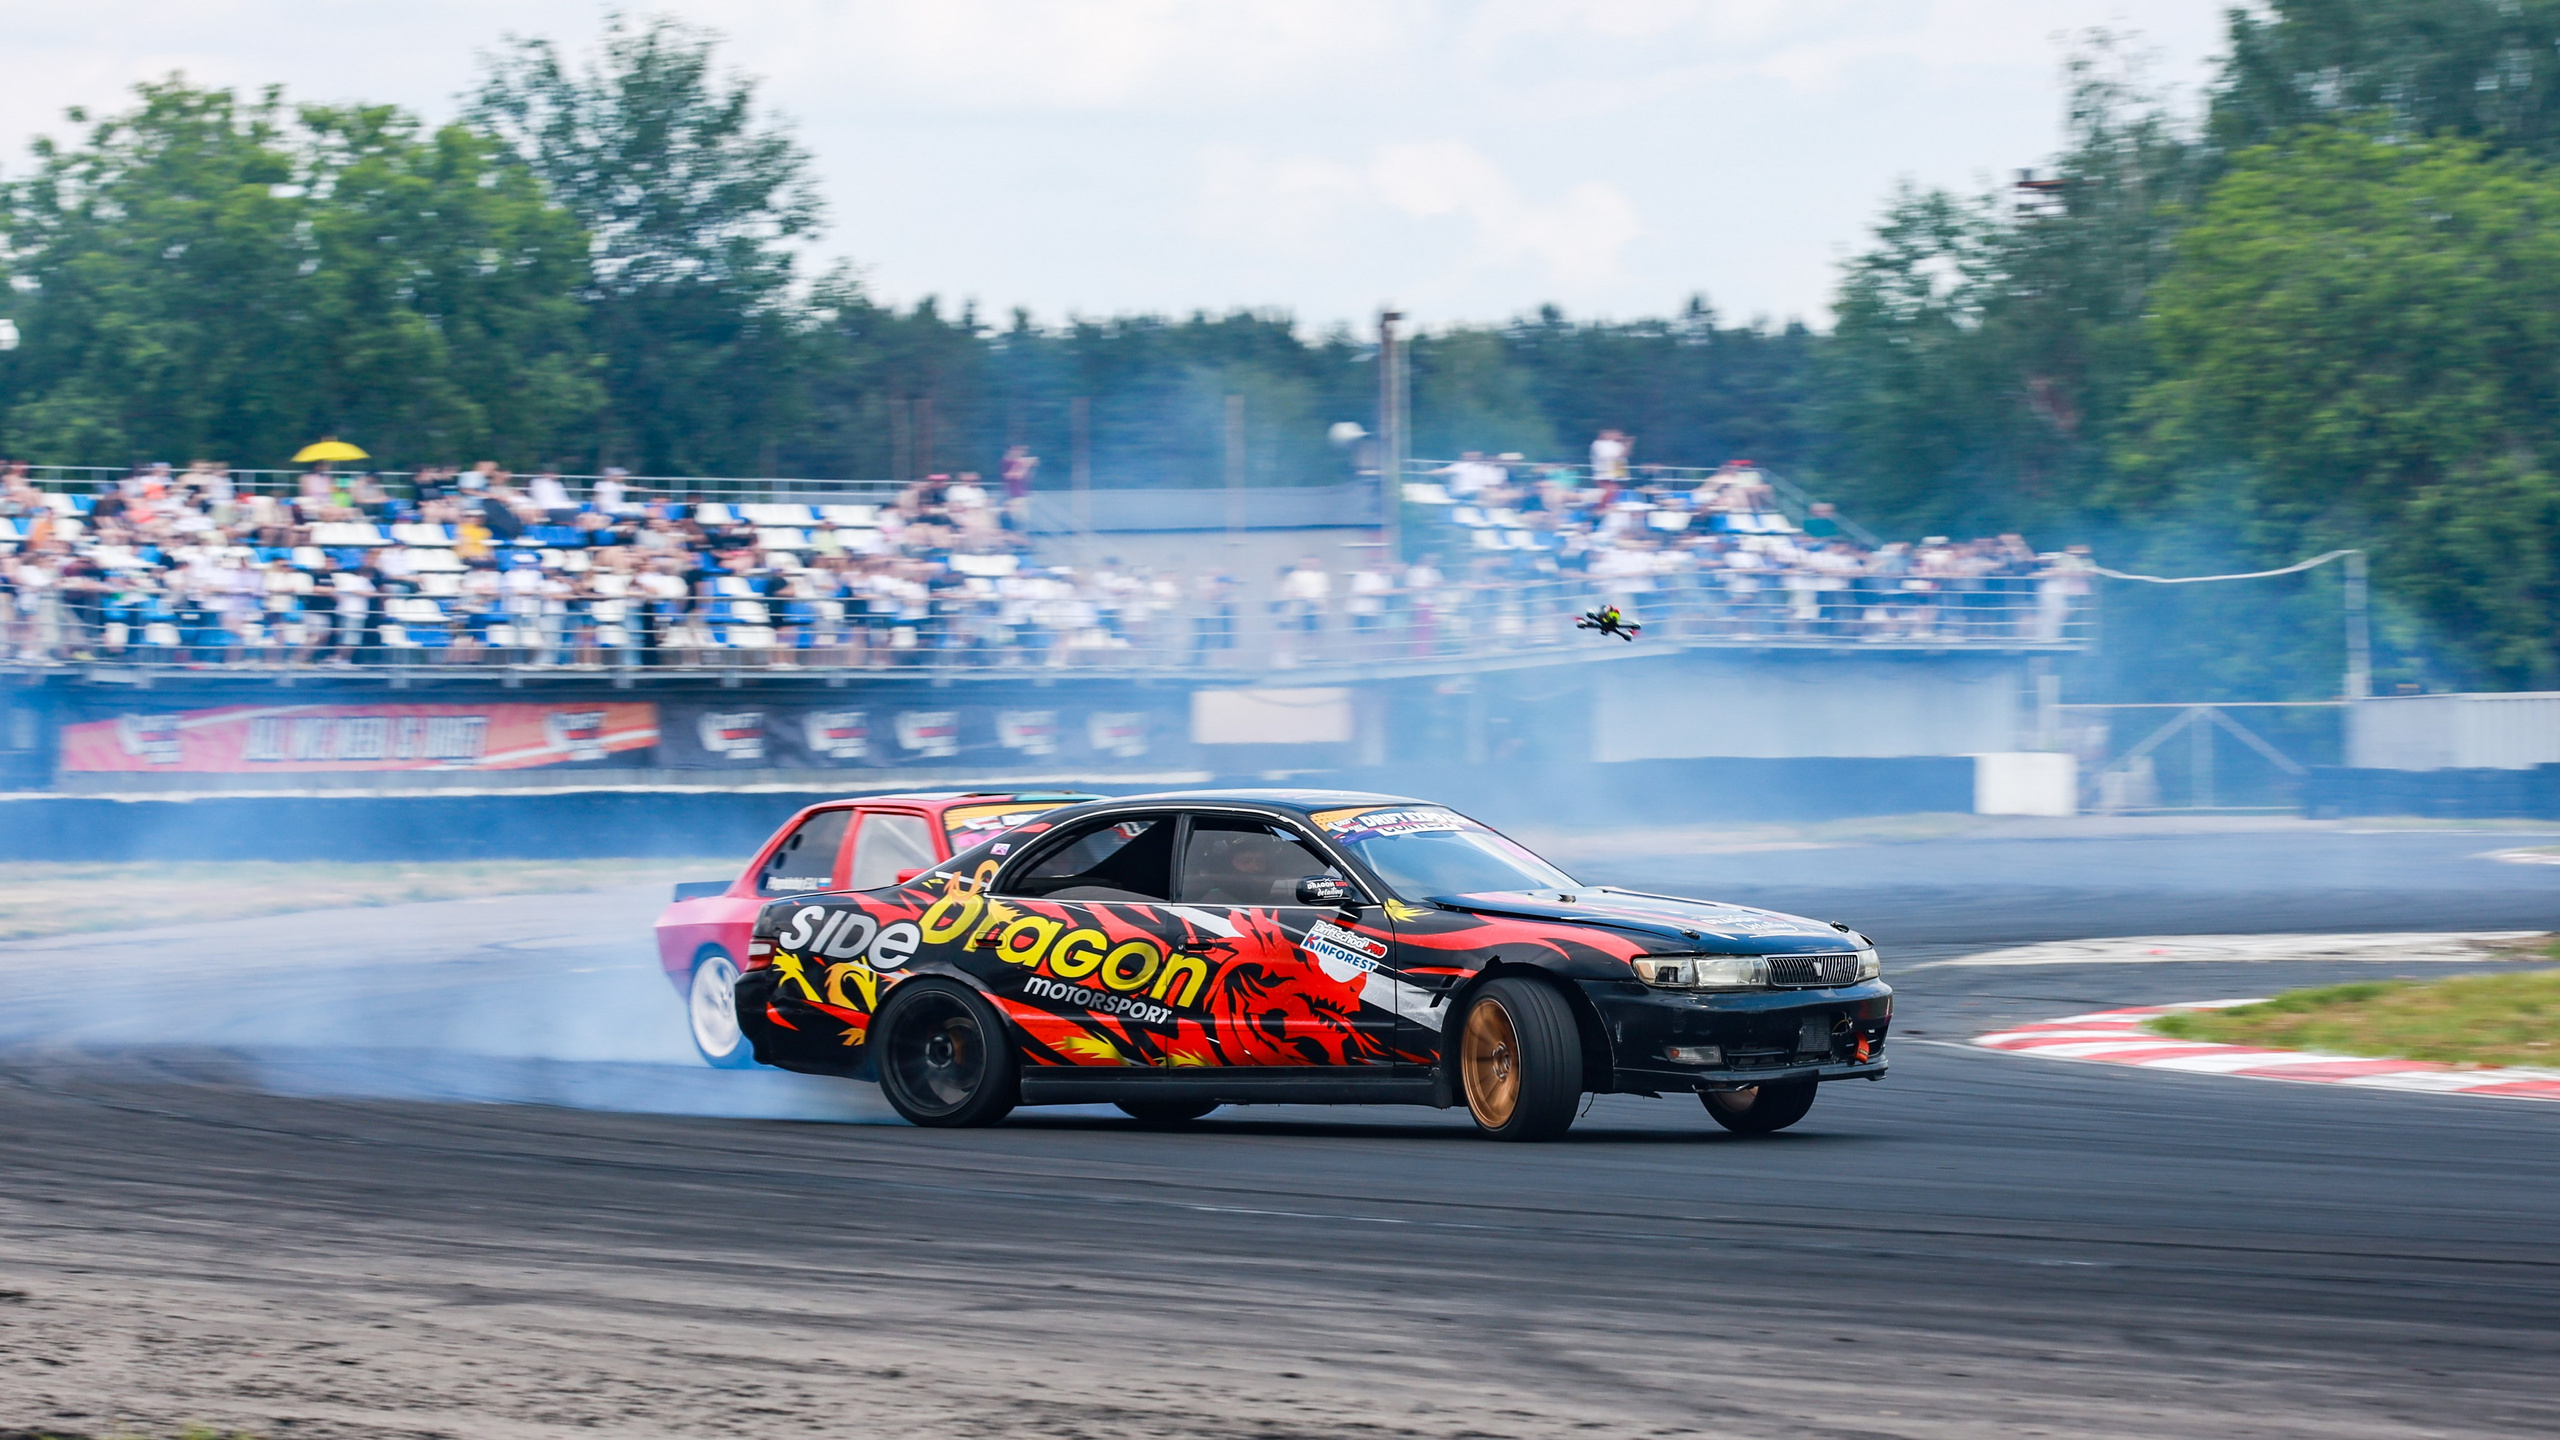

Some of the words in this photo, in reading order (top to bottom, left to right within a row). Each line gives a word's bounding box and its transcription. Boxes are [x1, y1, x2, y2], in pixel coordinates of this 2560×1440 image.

[1359, 812, 1408, 827] DRIFT
[1403, 811, 1446, 824] EXPO
[1303, 933, 1376, 971] KINFOREST
